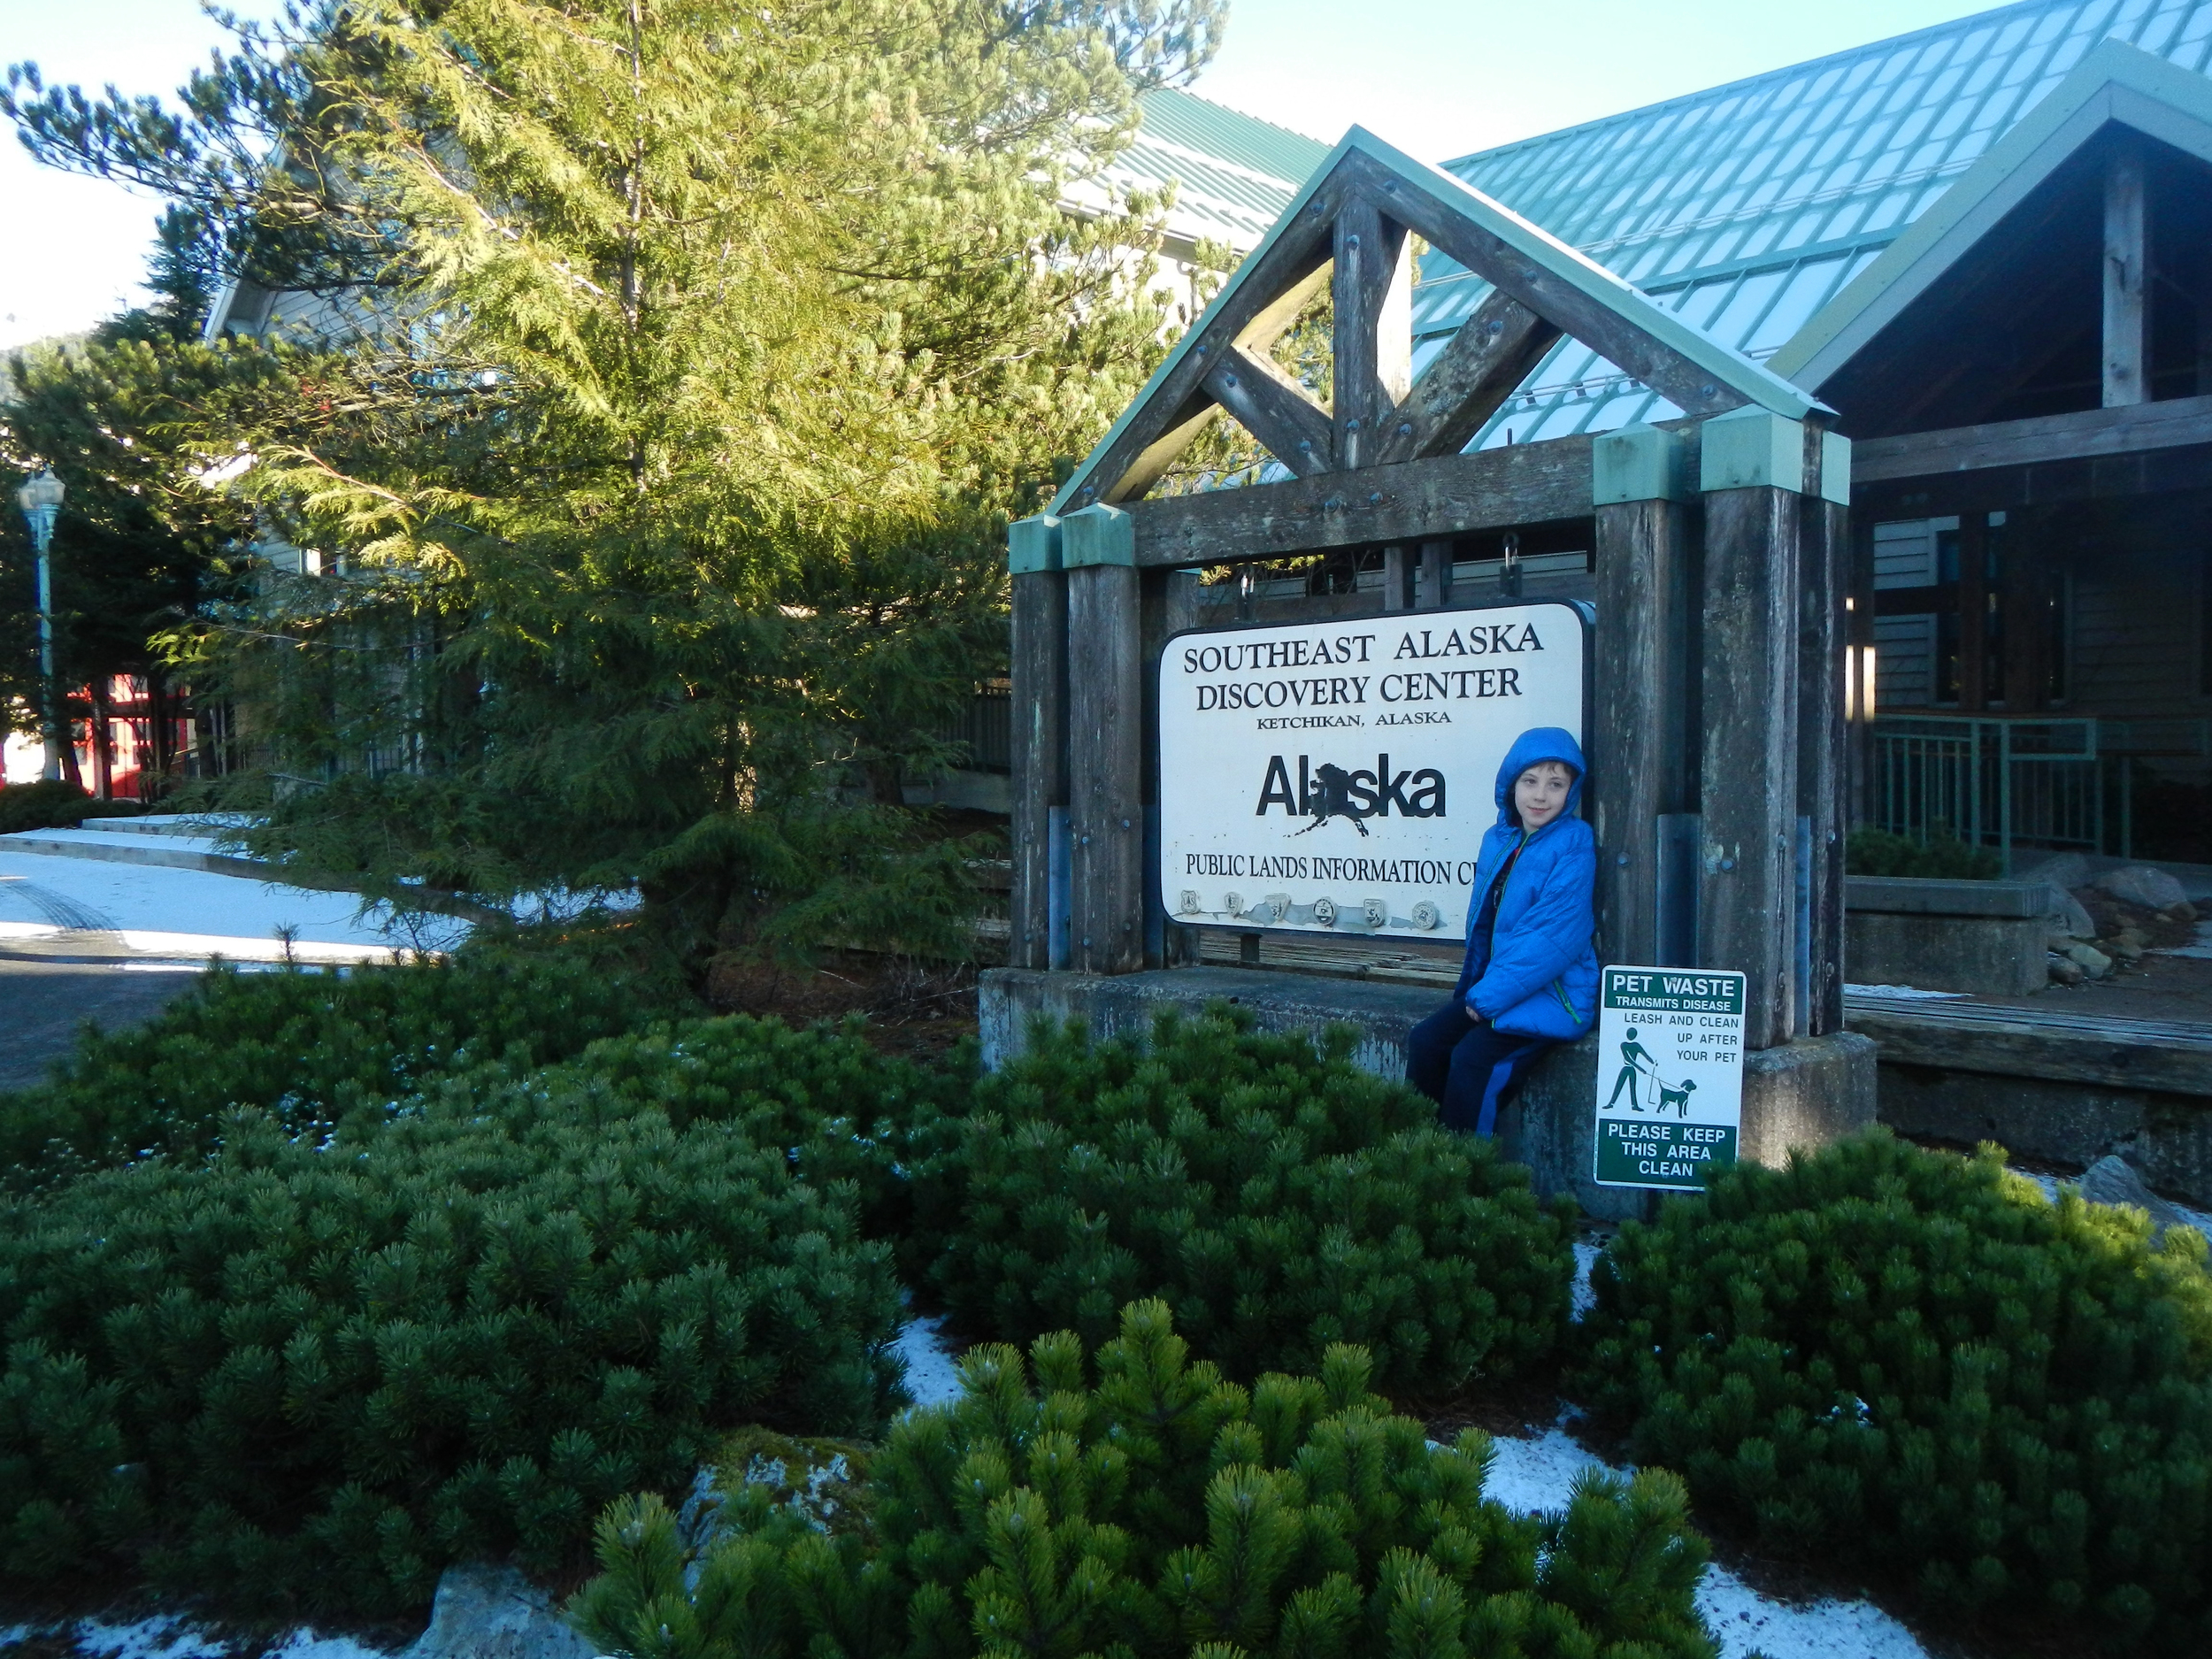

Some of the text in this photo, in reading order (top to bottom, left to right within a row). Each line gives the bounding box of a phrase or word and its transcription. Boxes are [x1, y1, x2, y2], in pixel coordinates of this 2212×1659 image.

[1183, 621, 1544, 674] SOUTHEAST ALASKA
[1196, 667, 1523, 710] DISCOVERY CENTER
[1256, 710, 1452, 730] KETCHIKAN, ALASKA
[1186, 853, 1244, 877] PUBLIC
[1249, 856, 1308, 880] LANDS
[1312, 856, 1452, 885] INFORMATION
[1612, 974, 1735, 997] PET WASTE
[1616, 995, 1731, 1011] TRANSMITS DISEASE
[1624, 1013, 1739, 1028] LEASH AND CLEAN
[1678, 1033, 1738, 1045] UP AFTER
[1677, 1050, 1737, 1063] YOUR PET
[1608, 1123, 1726, 1142] PLEASE KEEP
[1622, 1142, 1711, 1160] THIS AREA
[1639, 1161, 1694, 1177] CLEAN
